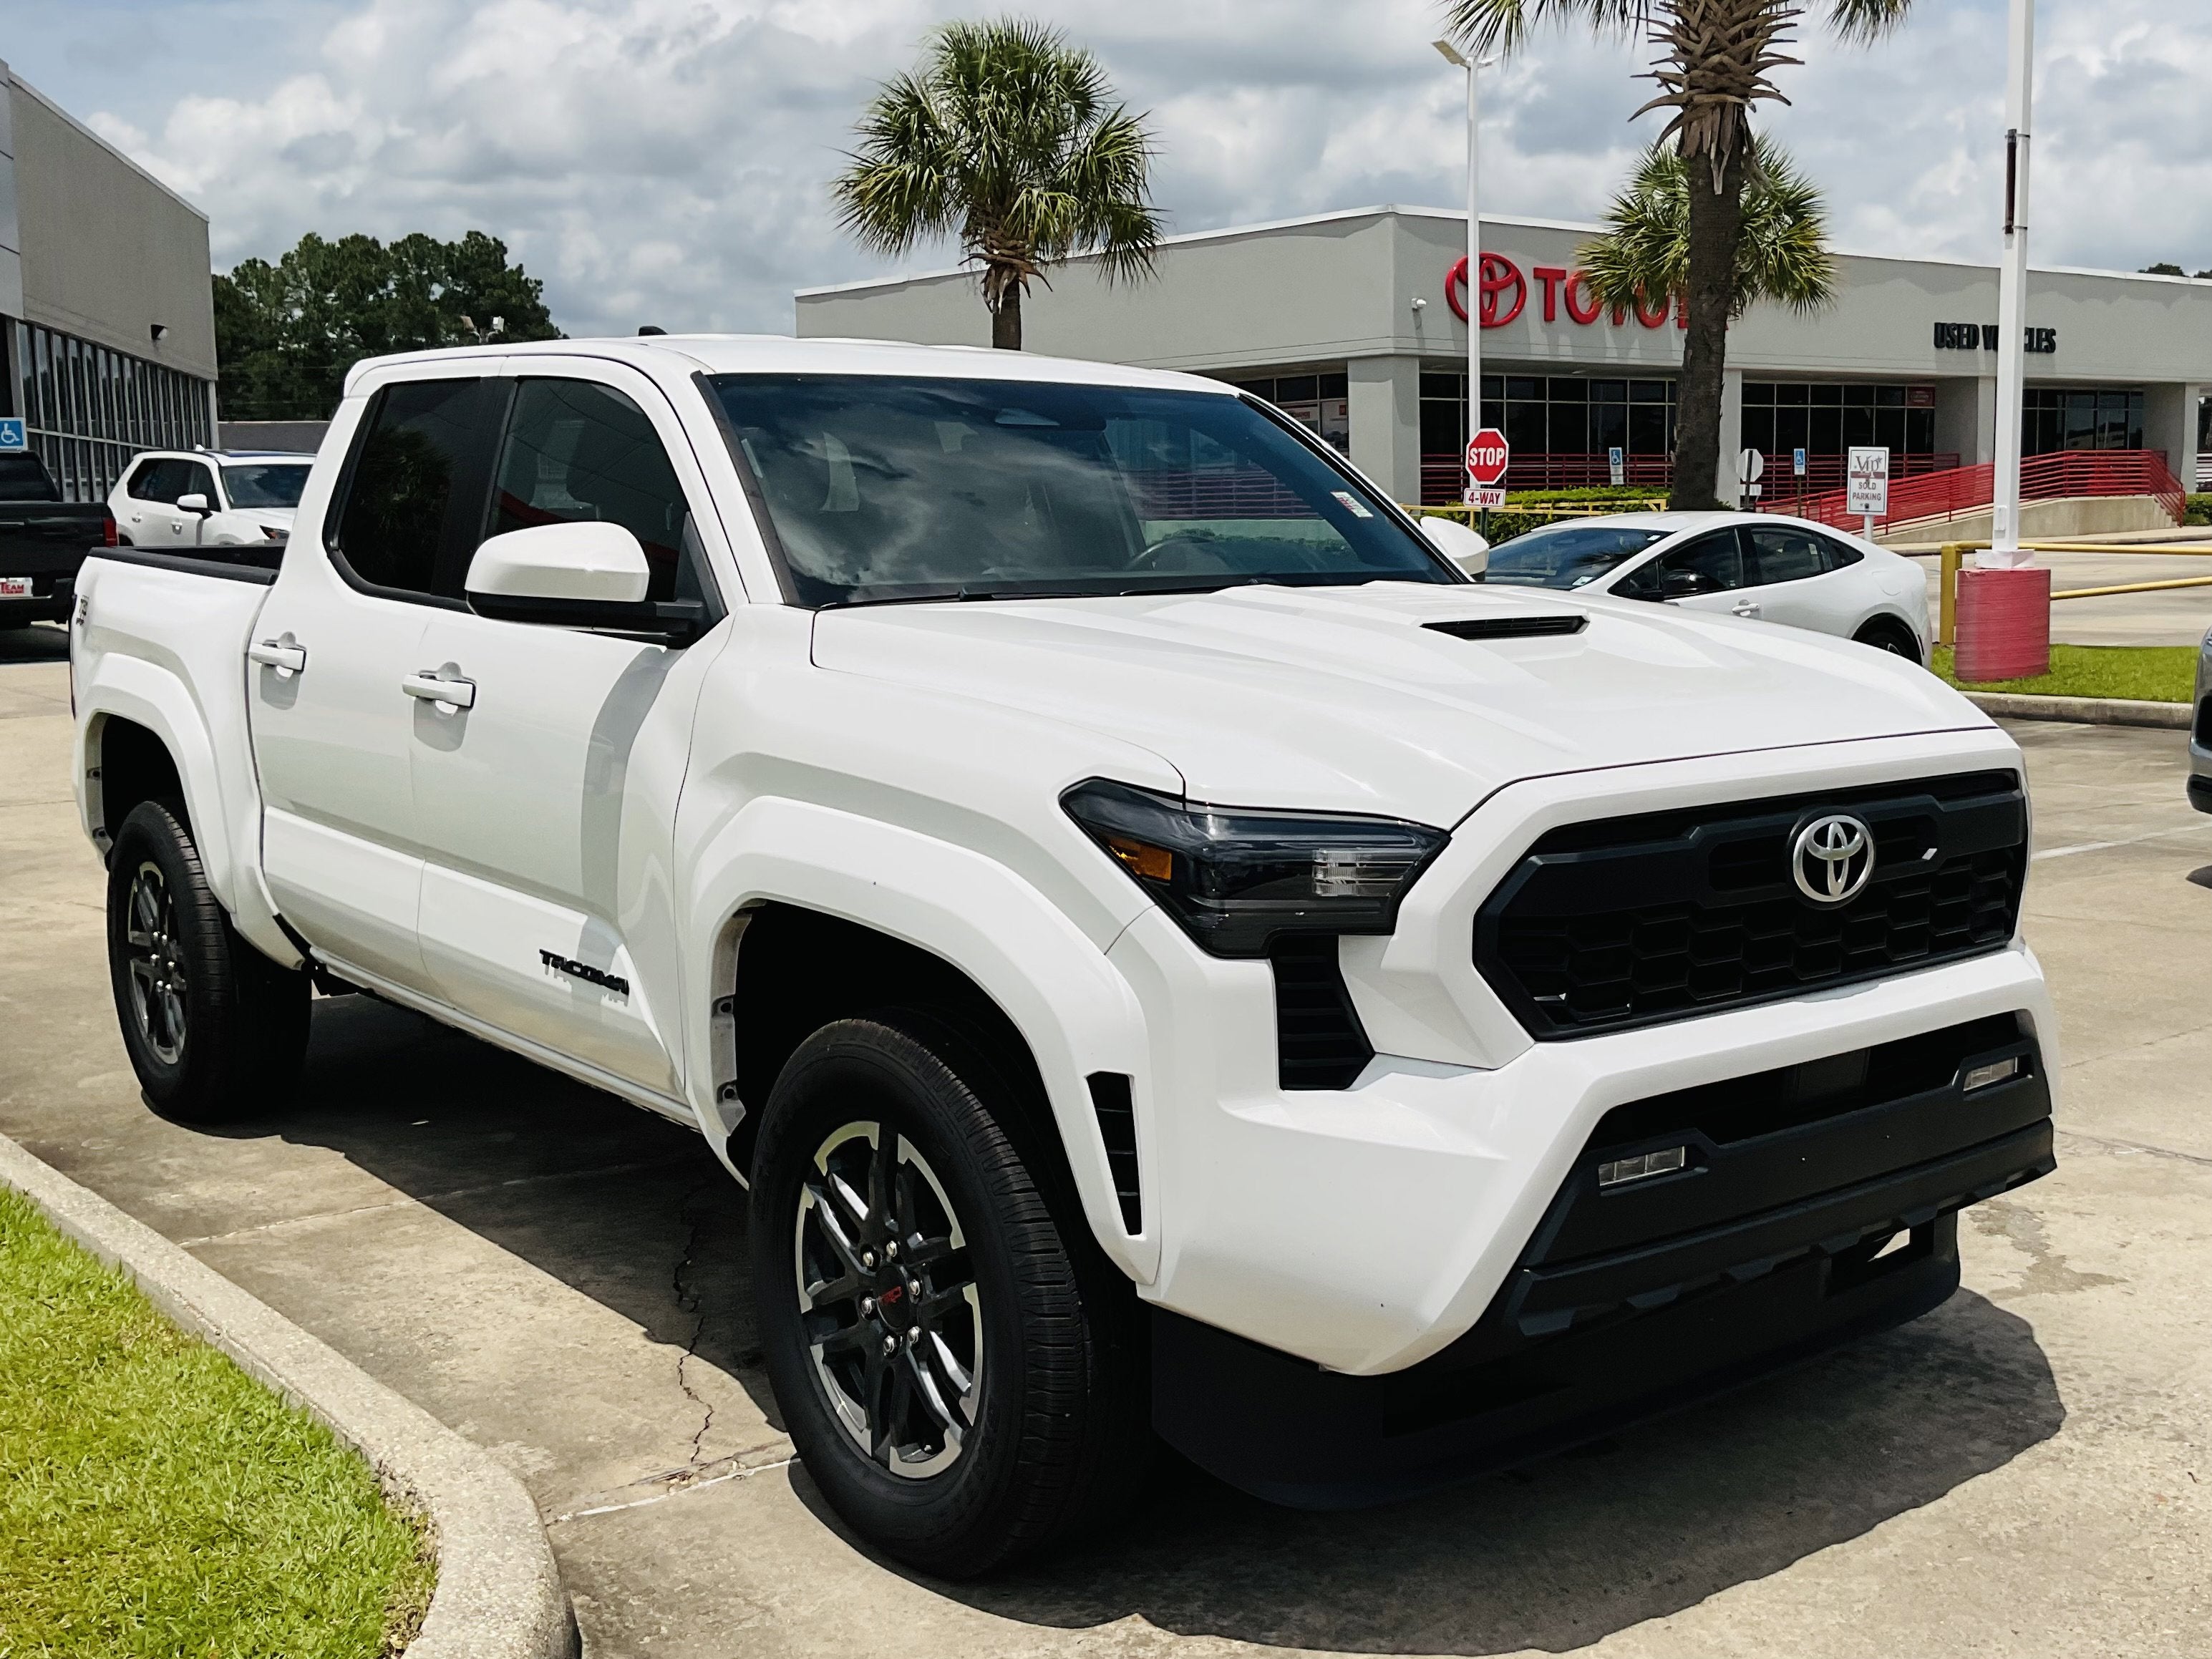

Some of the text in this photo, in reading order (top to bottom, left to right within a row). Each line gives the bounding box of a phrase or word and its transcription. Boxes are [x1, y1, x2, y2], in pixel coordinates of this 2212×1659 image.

[1934, 322, 1979, 349] USED
[1469, 447, 1505, 466] STOP
[1858, 482, 1876, 490] SOLD
[1468, 492, 1500, 505] 4-WAY
[1852, 492, 1881, 501] PARKING
